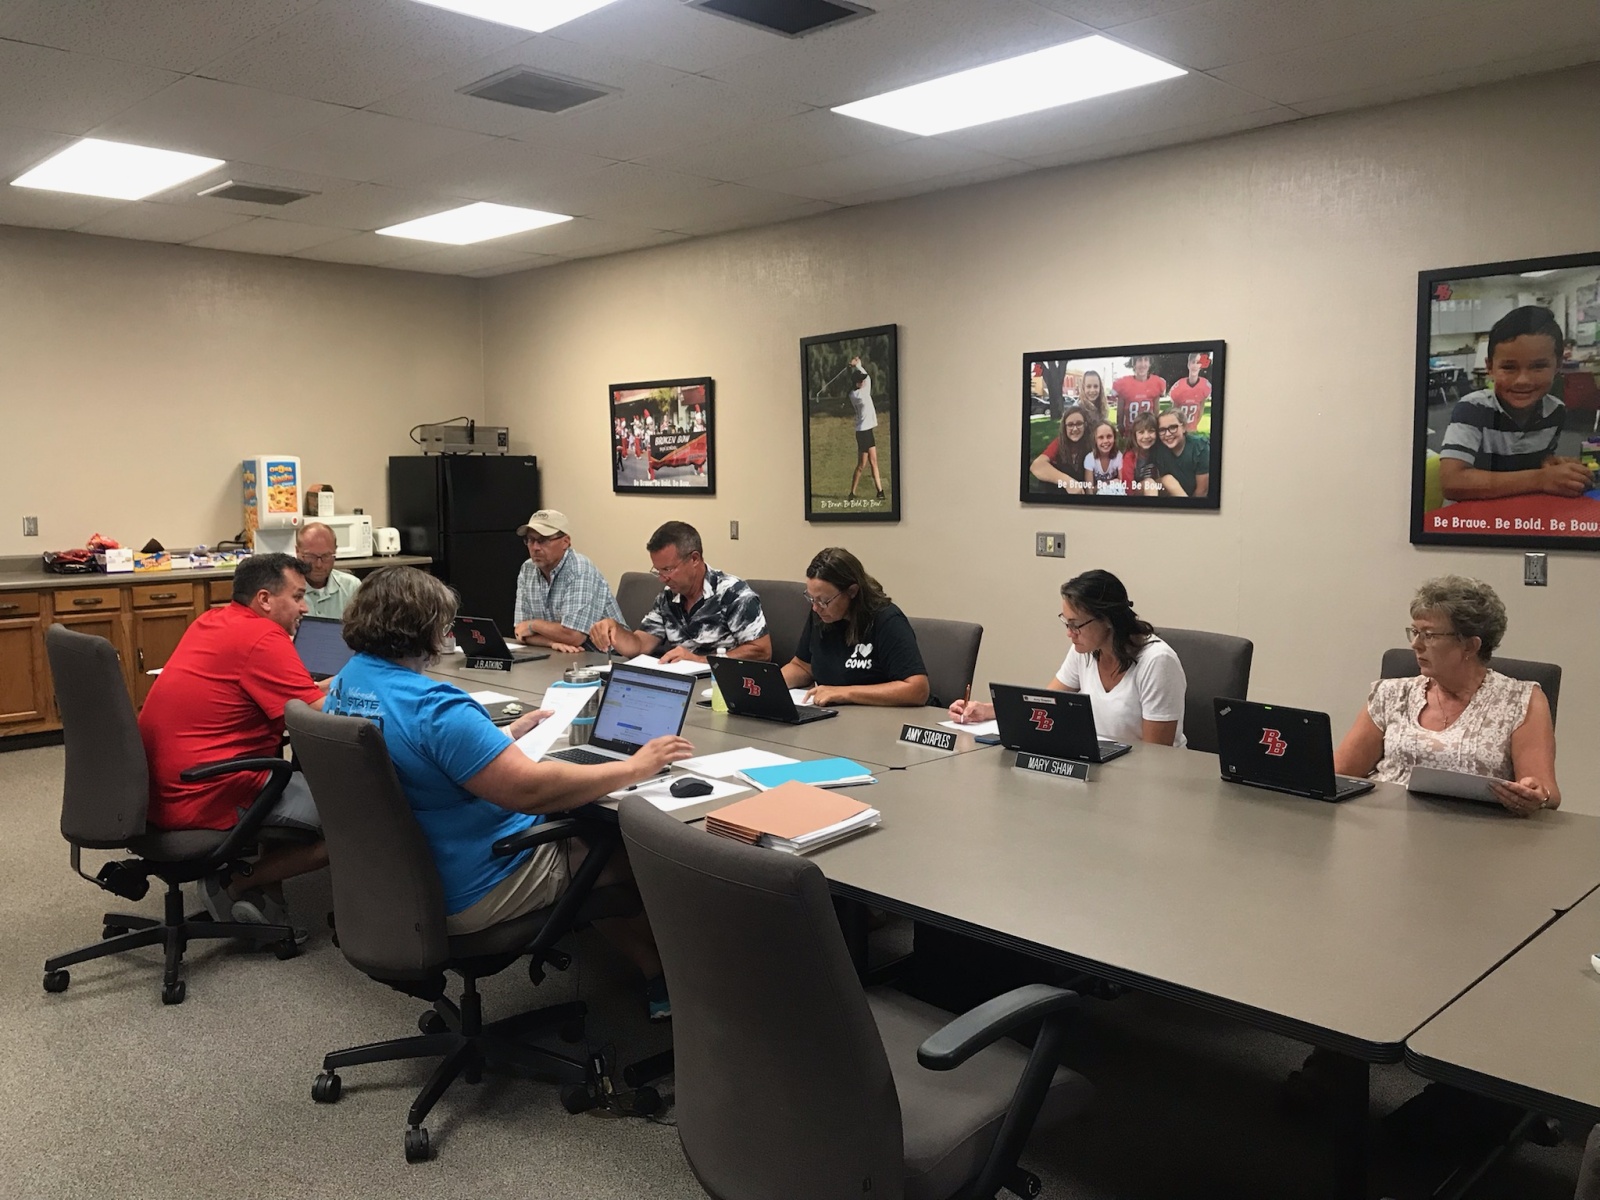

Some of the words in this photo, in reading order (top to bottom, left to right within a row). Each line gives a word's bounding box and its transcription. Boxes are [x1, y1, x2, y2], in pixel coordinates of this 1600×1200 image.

[655, 435, 677, 446] BROKEN
[677, 434, 690, 443] BOW
[1057, 480, 1067, 489] Be
[1069, 480, 1094, 490] Brave.
[1097, 480, 1107, 490] Be
[1109, 480, 1129, 490] Bold.
[1131, 480, 1142, 490] Be
[1144, 481, 1165, 491] Bow.
[1434, 516, 1448, 528] Be
[1452, 516, 1490, 529] Brave.
[1495, 517, 1511, 529] Be
[1514, 518, 1545, 530] Bold.
[1550, 519, 1566, 531] Be
[470, 629, 486, 645] BB
[850, 643, 860, 658] I
[845, 658, 872, 670] COWS
[742, 677, 761, 697] BB
[347, 697, 380, 710] STATE
[1029, 707, 1054, 732] BB
[905, 727, 923, 742] AMY
[922, 730, 951, 749] STAPLES
[1258, 727, 1288, 757] BB
[1028, 757, 1050, 771] MARY
[1051, 760, 1074, 776] SHAW
